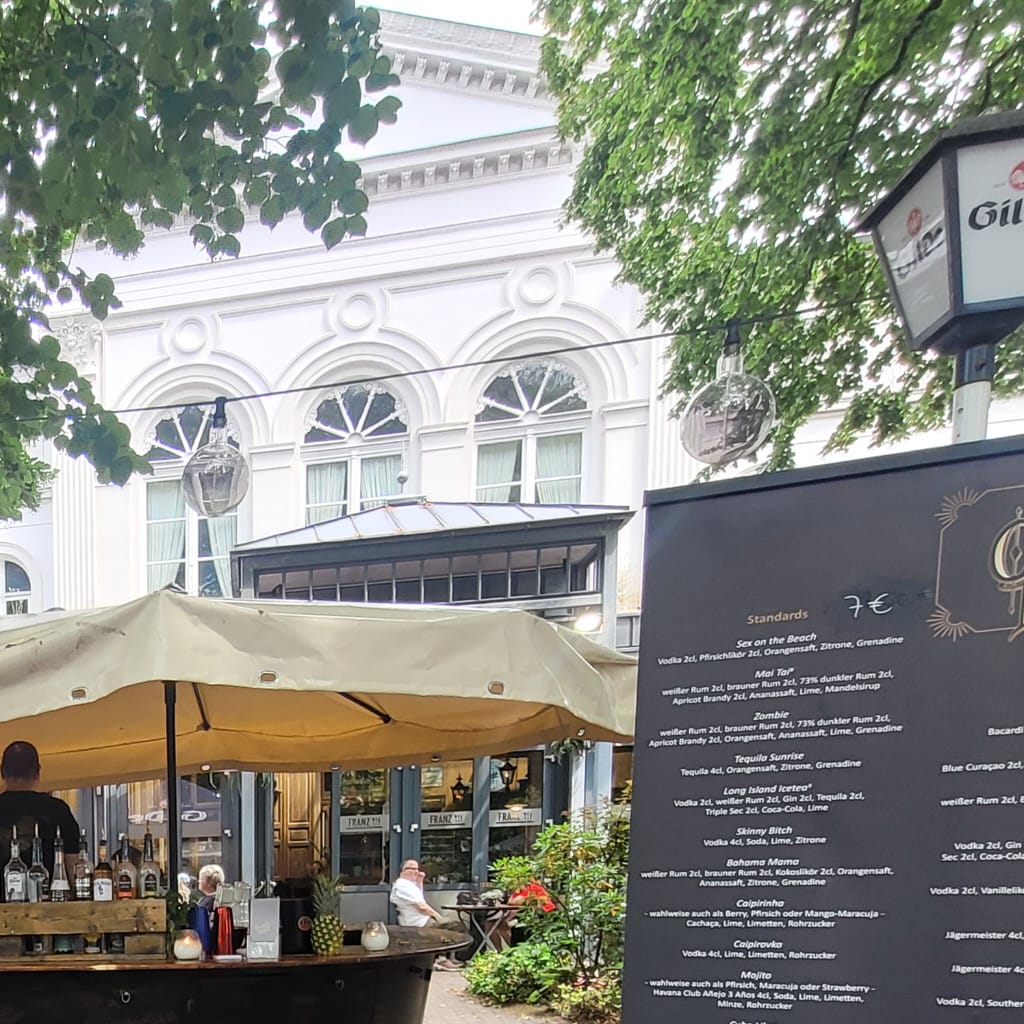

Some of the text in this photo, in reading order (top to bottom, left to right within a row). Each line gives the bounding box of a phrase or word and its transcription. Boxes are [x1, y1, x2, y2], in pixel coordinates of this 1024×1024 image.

[747, 609, 808, 625] Standards
[736, 632, 817, 649] Sex on the Beach
[658, 637, 904, 665] Vodka 2cl, Pfirsichlikör 2cl, Orangensaft, Zitrone, Grenadine
[755, 669, 775, 678] Mai
[672, 697, 702, 706] Apricot
[703, 694, 732, 703] Brandy
[733, 693, 748, 701] 2cl,
[749, 689, 798, 699] Ananassaft,
[825, 683, 881, 693] Mandelsirup
[753, 711, 790, 721] Zombie
[735, 752, 805, 764] Tequila Sunrise
[681, 768, 709, 777] Tequila
[726, 764, 779, 774] Orangensaft,
[780, 763, 814, 771] Zitrone,
[815, 760, 862, 769] Grenadine
[942, 761, 1024, 773] Blue Curaçao 2cl,
[723, 787, 747, 796] Long
[748, 785, 778, 794] Island
[940, 796, 1018, 806] weißer Rum 2cl,
[705, 808, 728, 817] Triple
[745, 806, 760, 814] 2cl,
[761, 805, 806, 814] Coca-Cola,
[808, 804, 829, 812] Lime
[736, 826, 793, 837] Skinny Bitch
[704, 839, 729, 847] Vodka
[746, 838, 769, 846] Soda,
[795, 836, 827, 844] Zitrone
[954, 841, 1022, 850] Vodka 2cl, Gin
[942, 853, 959, 861] Sec
[960, 853, 977, 861] 2cl,
[726, 858, 800, 867] Bahama Mama
[699, 878, 826, 887] Ananassaft, Zitrone, Grenadine
[736, 899, 785, 909] Caipirinha
[686, 920, 836, 928] Cachaça, Lime, Limetten, Rohrzucker
[945, 931, 1007, 941] Jägermeister
[733, 940, 783, 950] Caipirovka
[724, 951, 746, 959] Lime,
[748, 951, 787, 959] Limetten,
[789, 951, 837, 959] Rohrzucker
[741, 971, 772, 981] Mojito
[717, 1000, 793, 1010] Minze, Rohrzucker
[936, 998, 966, 1006] Vodka
[968, 999, 985, 1008] 2cl,
